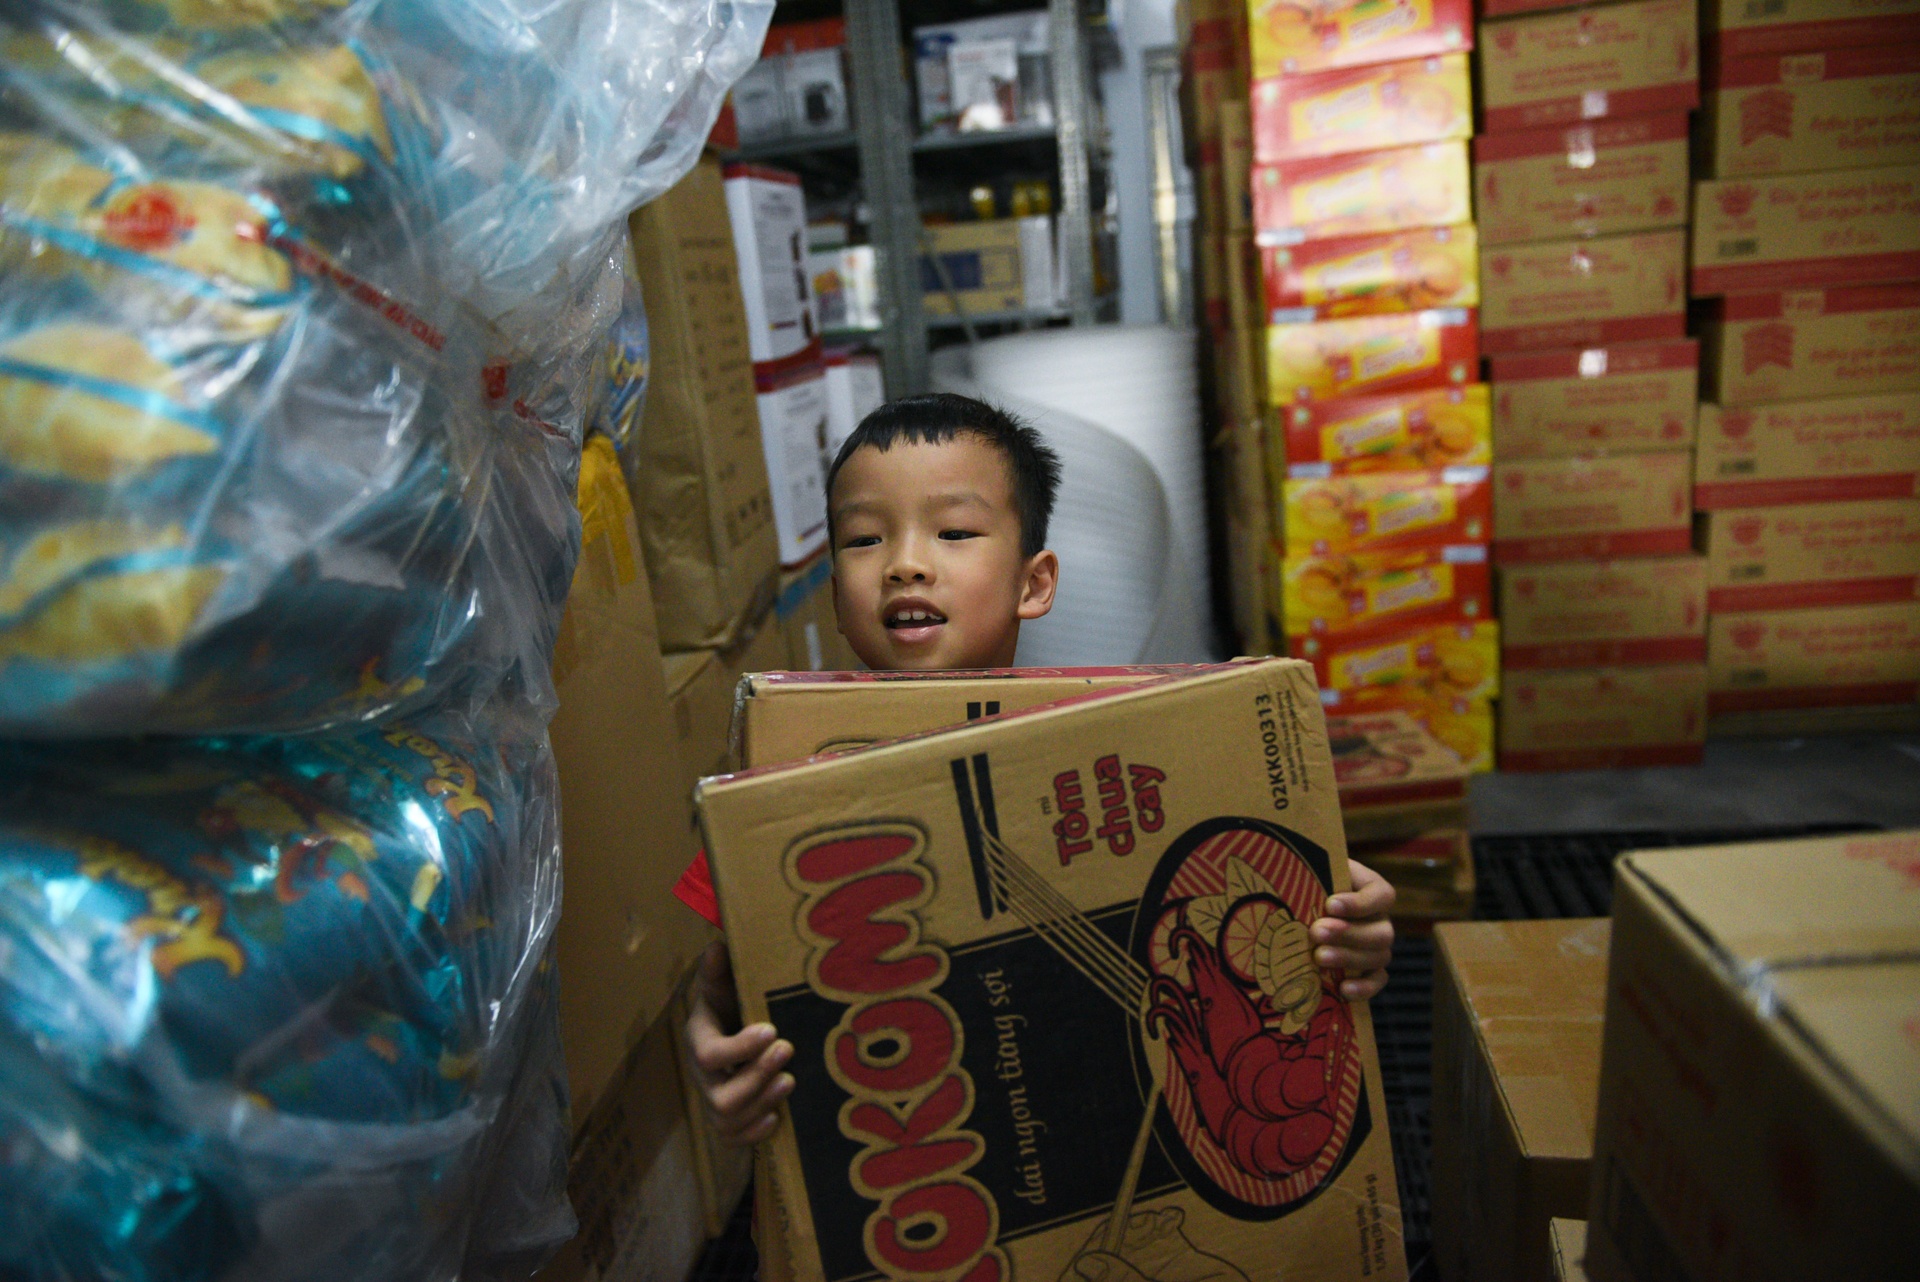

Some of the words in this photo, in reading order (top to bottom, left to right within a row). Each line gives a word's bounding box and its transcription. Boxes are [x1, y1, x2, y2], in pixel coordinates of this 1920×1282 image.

[1255, 693, 1289, 811] 02KK00313
[1053, 769, 1093, 867] Tôm
[1093, 753, 1136, 857] chua
[1127, 763, 1167, 834] cay
[1008, 1084, 1049, 1156] ngon
[1013, 1160, 1048, 1205] dai
